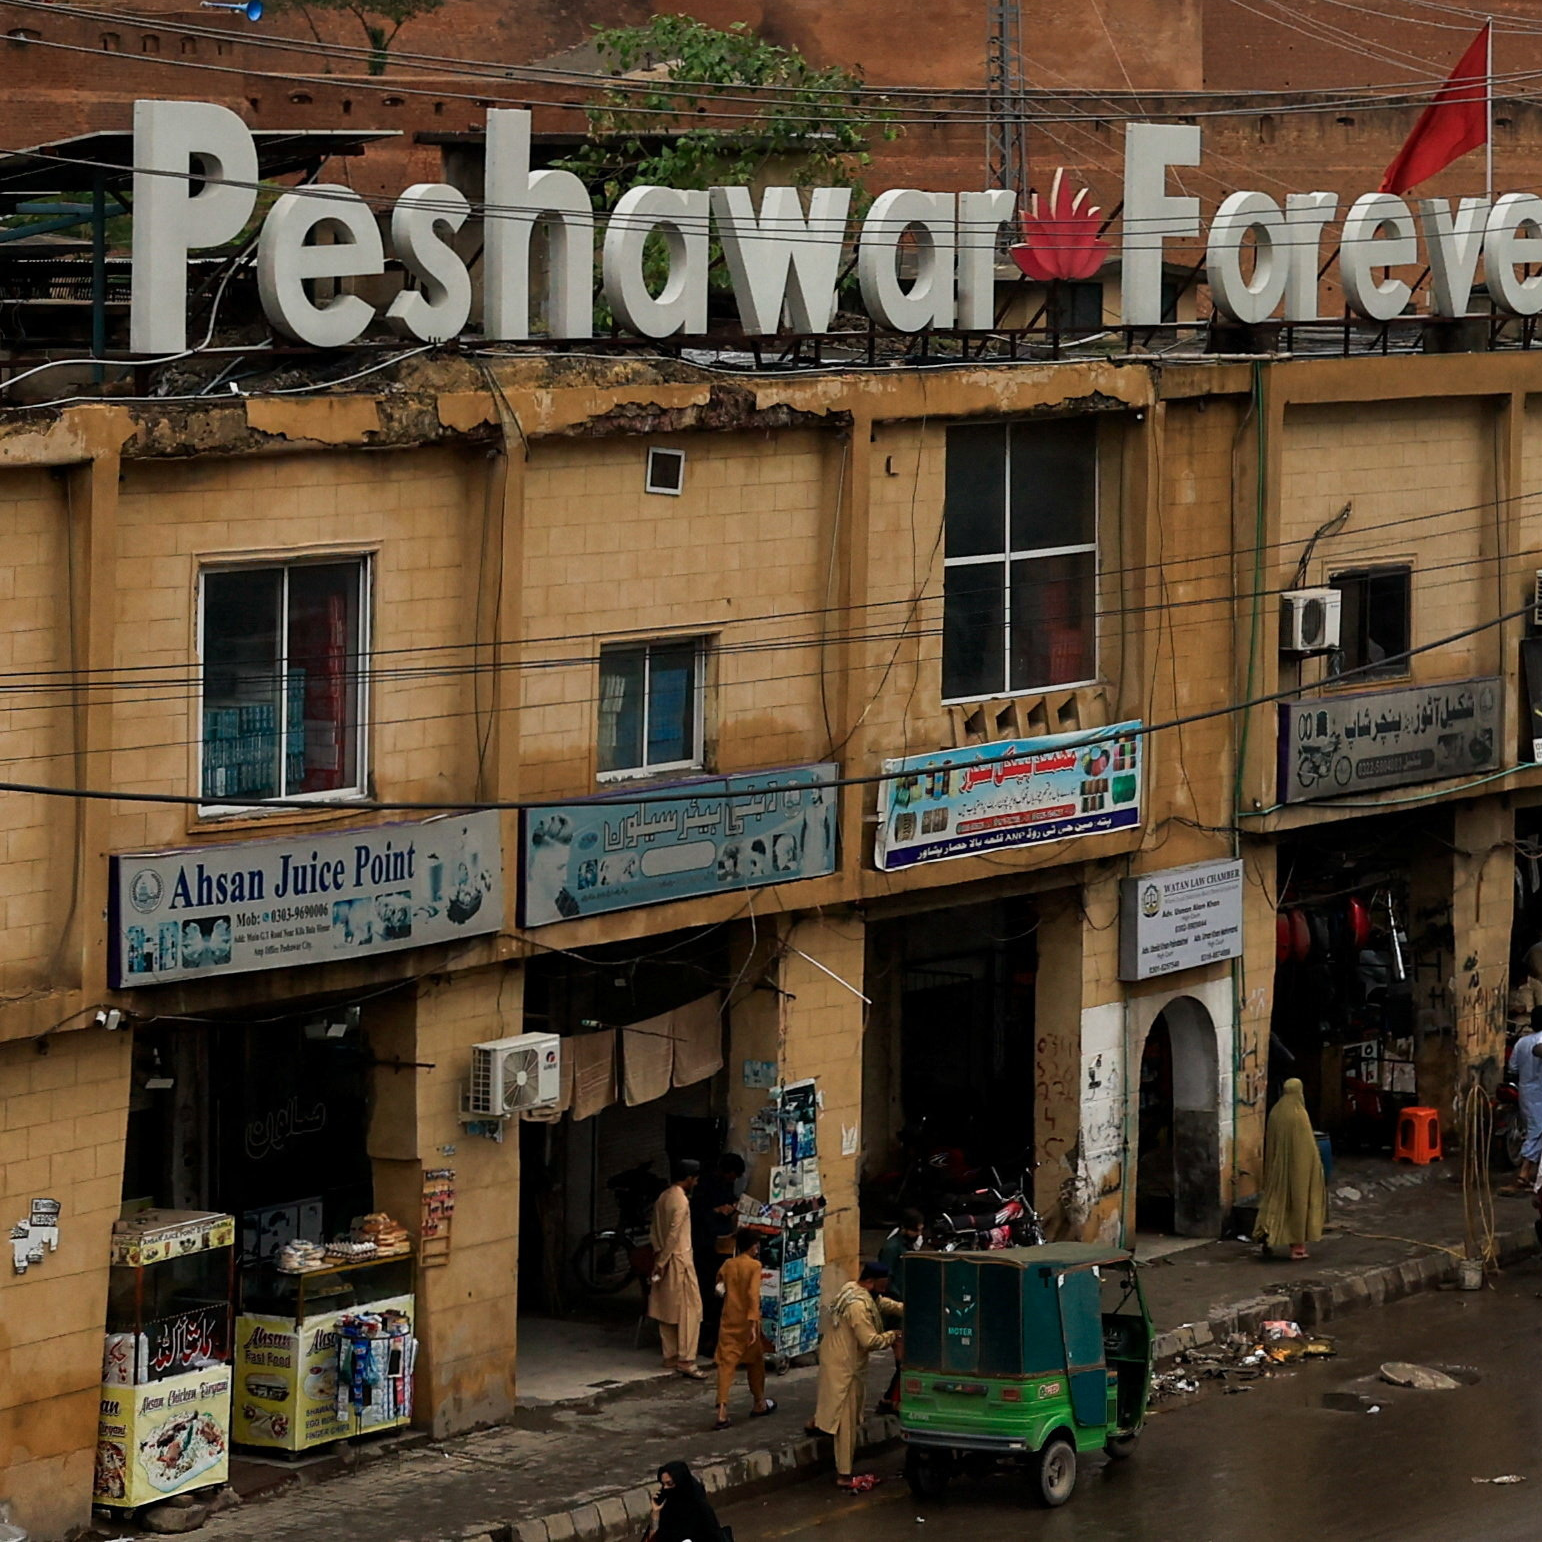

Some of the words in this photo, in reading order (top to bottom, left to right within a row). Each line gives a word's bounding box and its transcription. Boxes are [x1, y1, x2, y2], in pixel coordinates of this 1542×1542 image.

[130, 99, 1016, 353] Peshawar
[1005, 831, 1025, 842] ANP
[169, 864, 265, 910] Ahsan
[274, 851, 345, 899] Juice
[353, 840, 416, 888] Point
[1164, 879, 1190, 893] WATAN
[1190, 876, 1206, 888] LAW
[1207, 868, 1240, 884] CHAMBER
[236, 912, 261, 928] Mob:
[244, 1326, 293, 1350] Ahsan
[245, 1350, 266, 1366] Fast
[268, 1351, 292, 1369] Food
